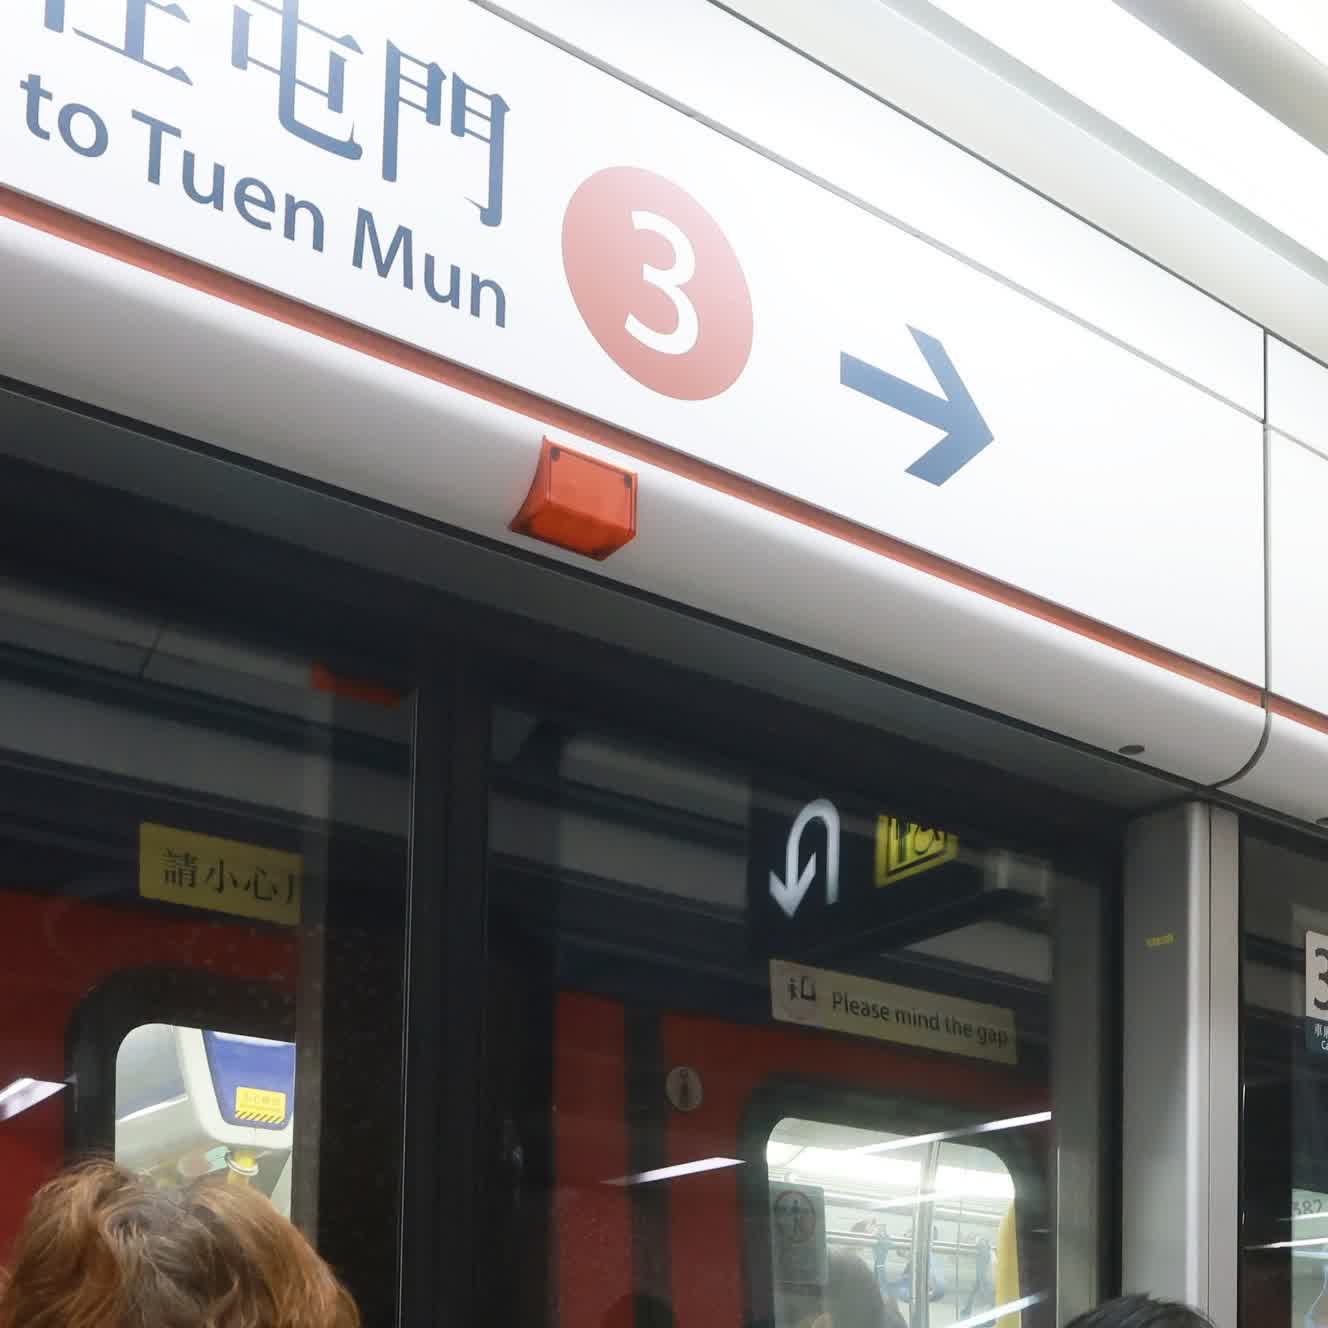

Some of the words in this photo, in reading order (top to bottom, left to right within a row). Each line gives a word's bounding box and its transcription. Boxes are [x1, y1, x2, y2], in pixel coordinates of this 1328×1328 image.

[19, 73, 109, 158] to
[131, 109, 325, 253] Tuen
[352, 207, 507, 328] Mun
[624, 209, 700, 356] 3
[832, 991, 890, 1021] Please
[894, 1008, 941, 1032] mind
[944, 1014, 973, 1039] the
[976, 1024, 1009, 1049] gap
